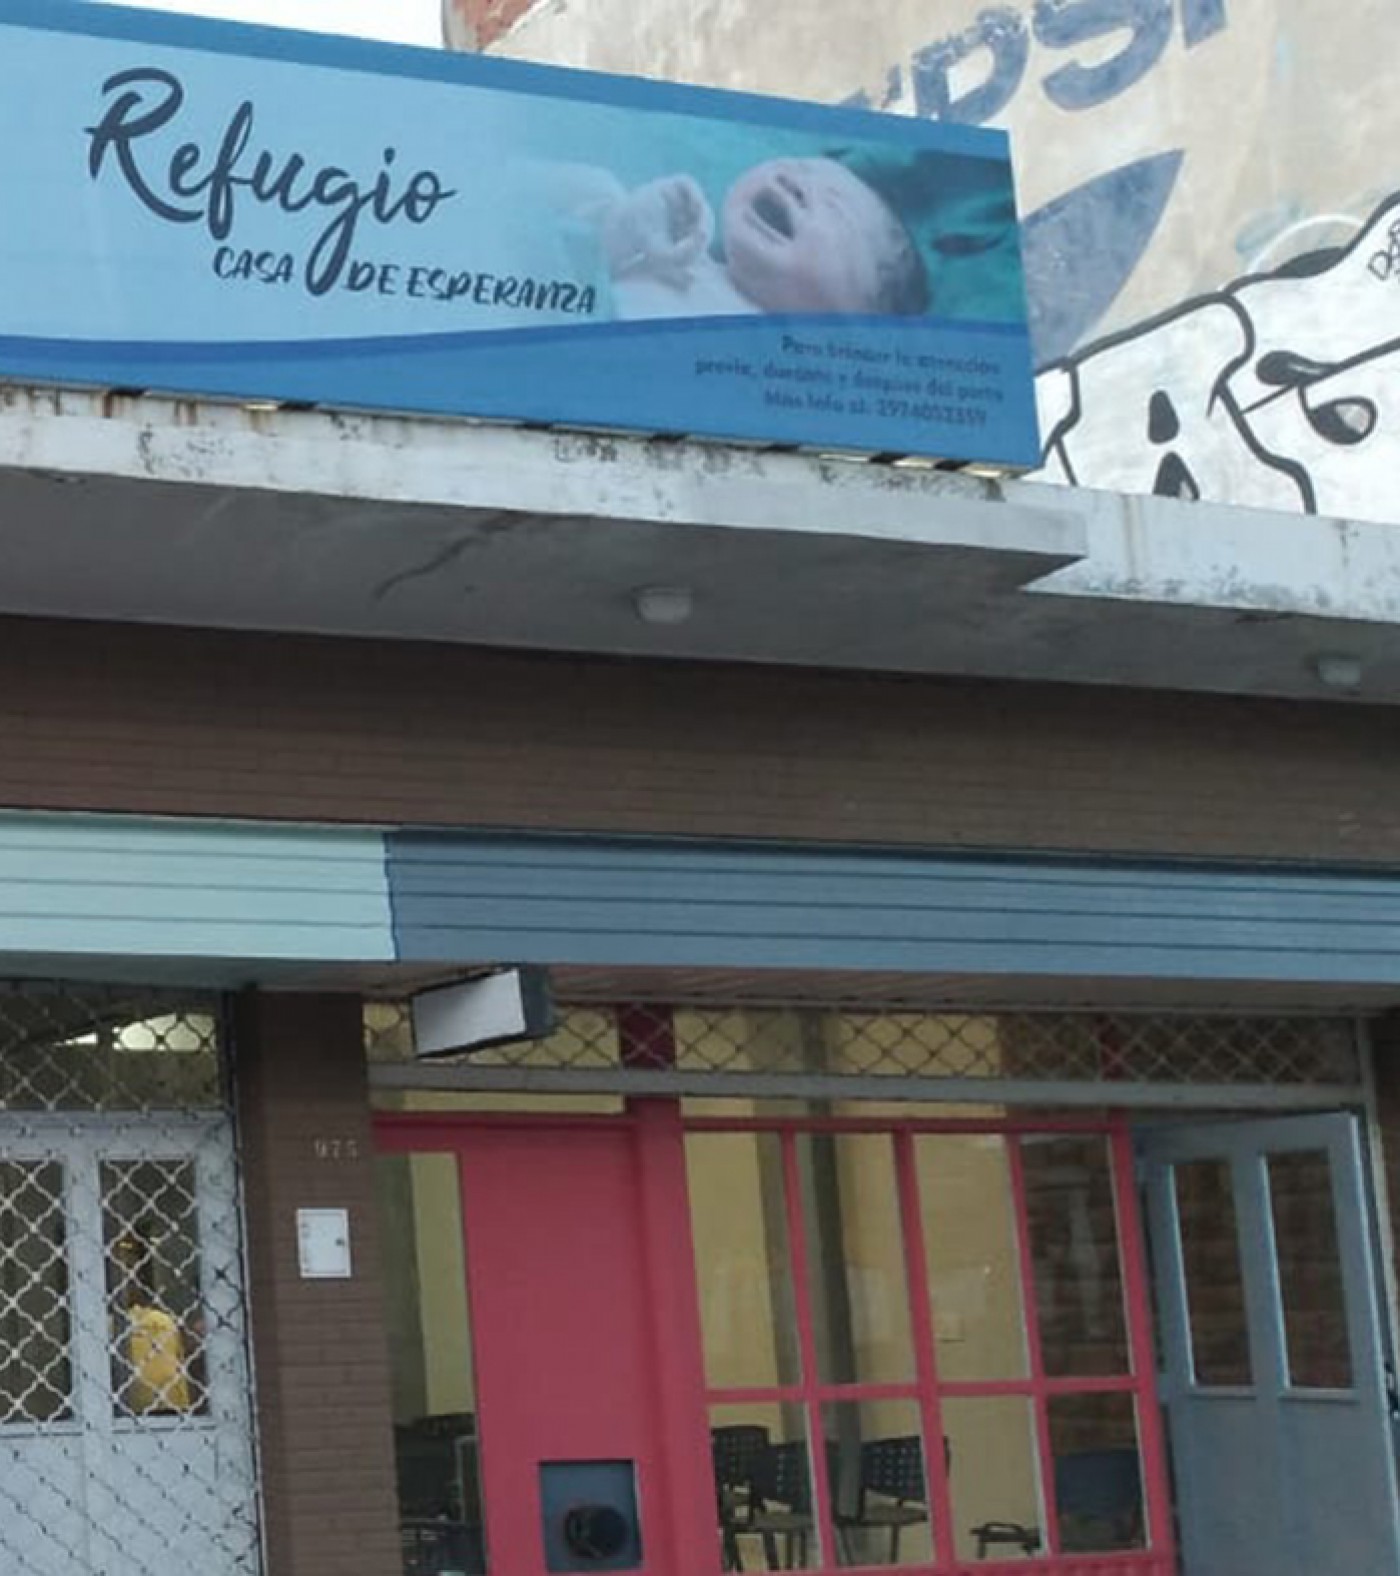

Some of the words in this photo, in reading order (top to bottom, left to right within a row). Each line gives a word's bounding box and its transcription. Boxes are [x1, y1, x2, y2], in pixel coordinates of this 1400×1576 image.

[84, 67, 458, 297] Refugio
[213, 244, 295, 284] CASA
[342, 259, 400, 296] DE
[405, 265, 598, 315] ESPERANZA
